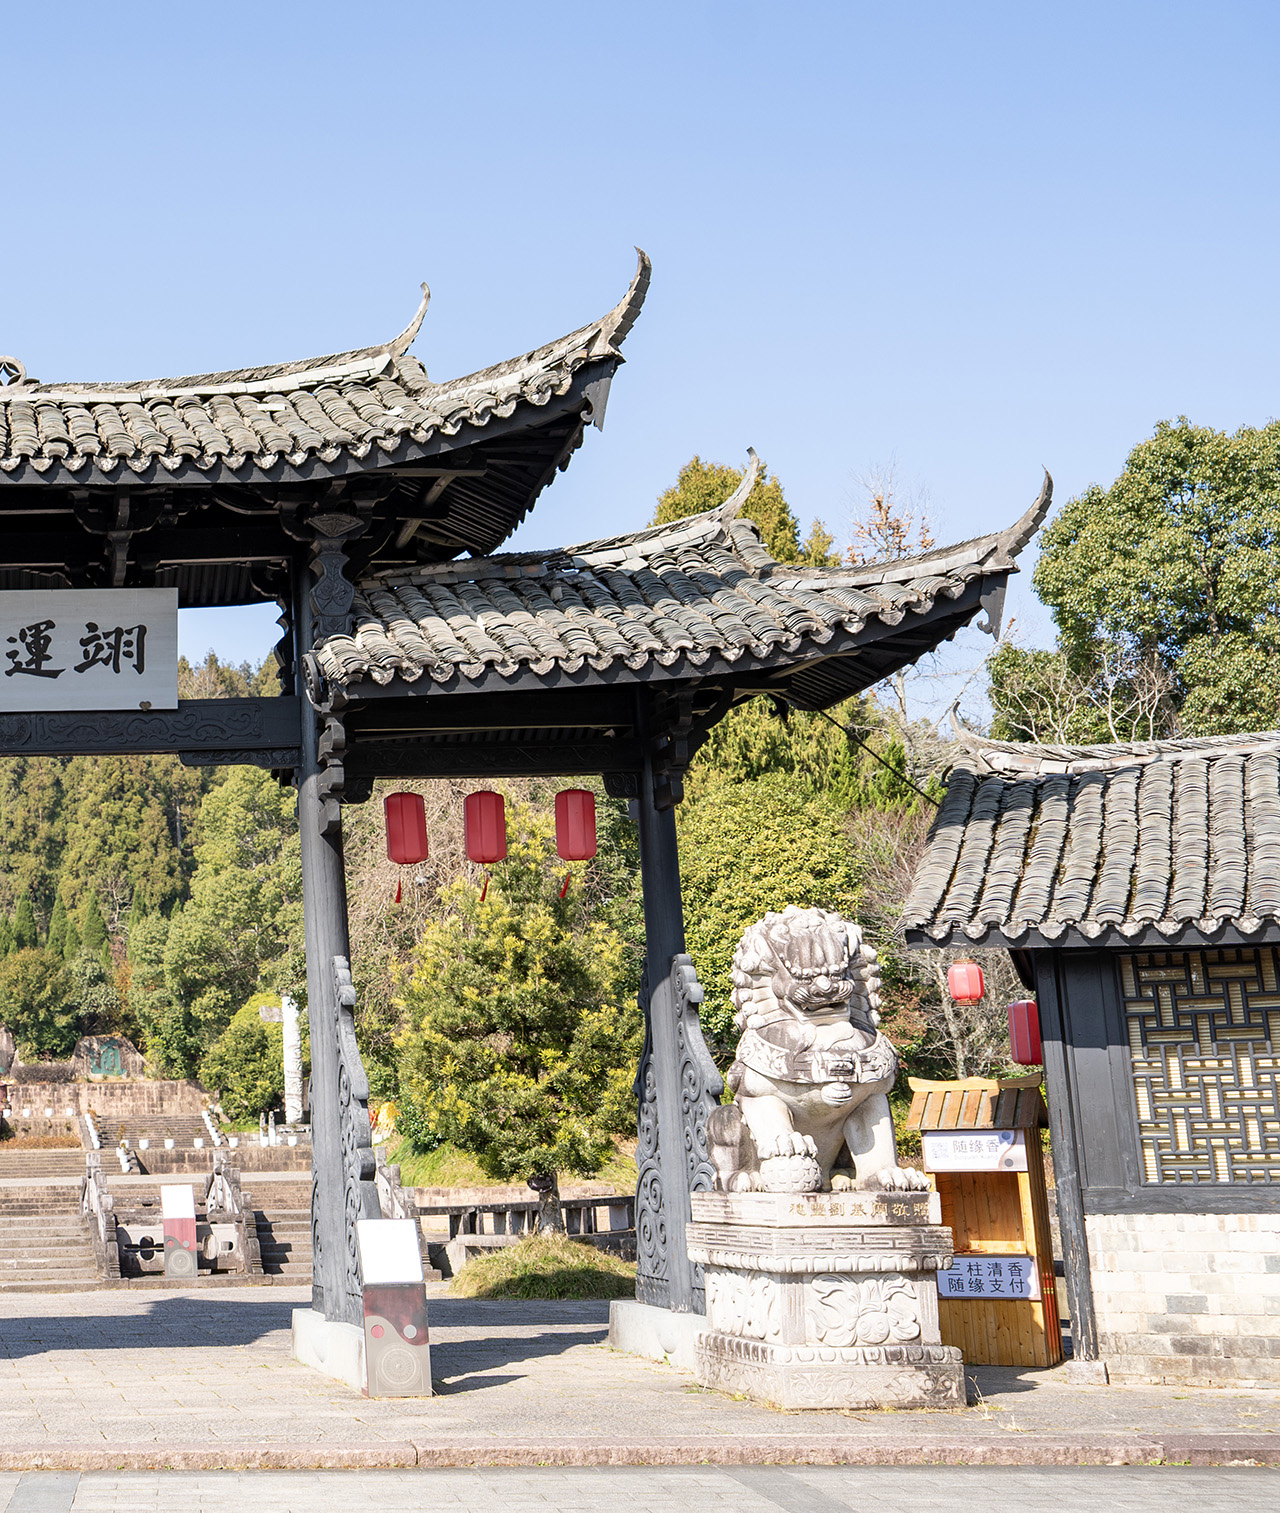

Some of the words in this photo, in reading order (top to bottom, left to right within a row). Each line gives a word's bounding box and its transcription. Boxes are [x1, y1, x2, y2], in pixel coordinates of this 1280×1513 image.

[952, 1138, 999, 1154] 随缘香
[947, 1261, 1023, 1278] 三柱清香
[948, 1277, 1025, 1294] 随缘支付
